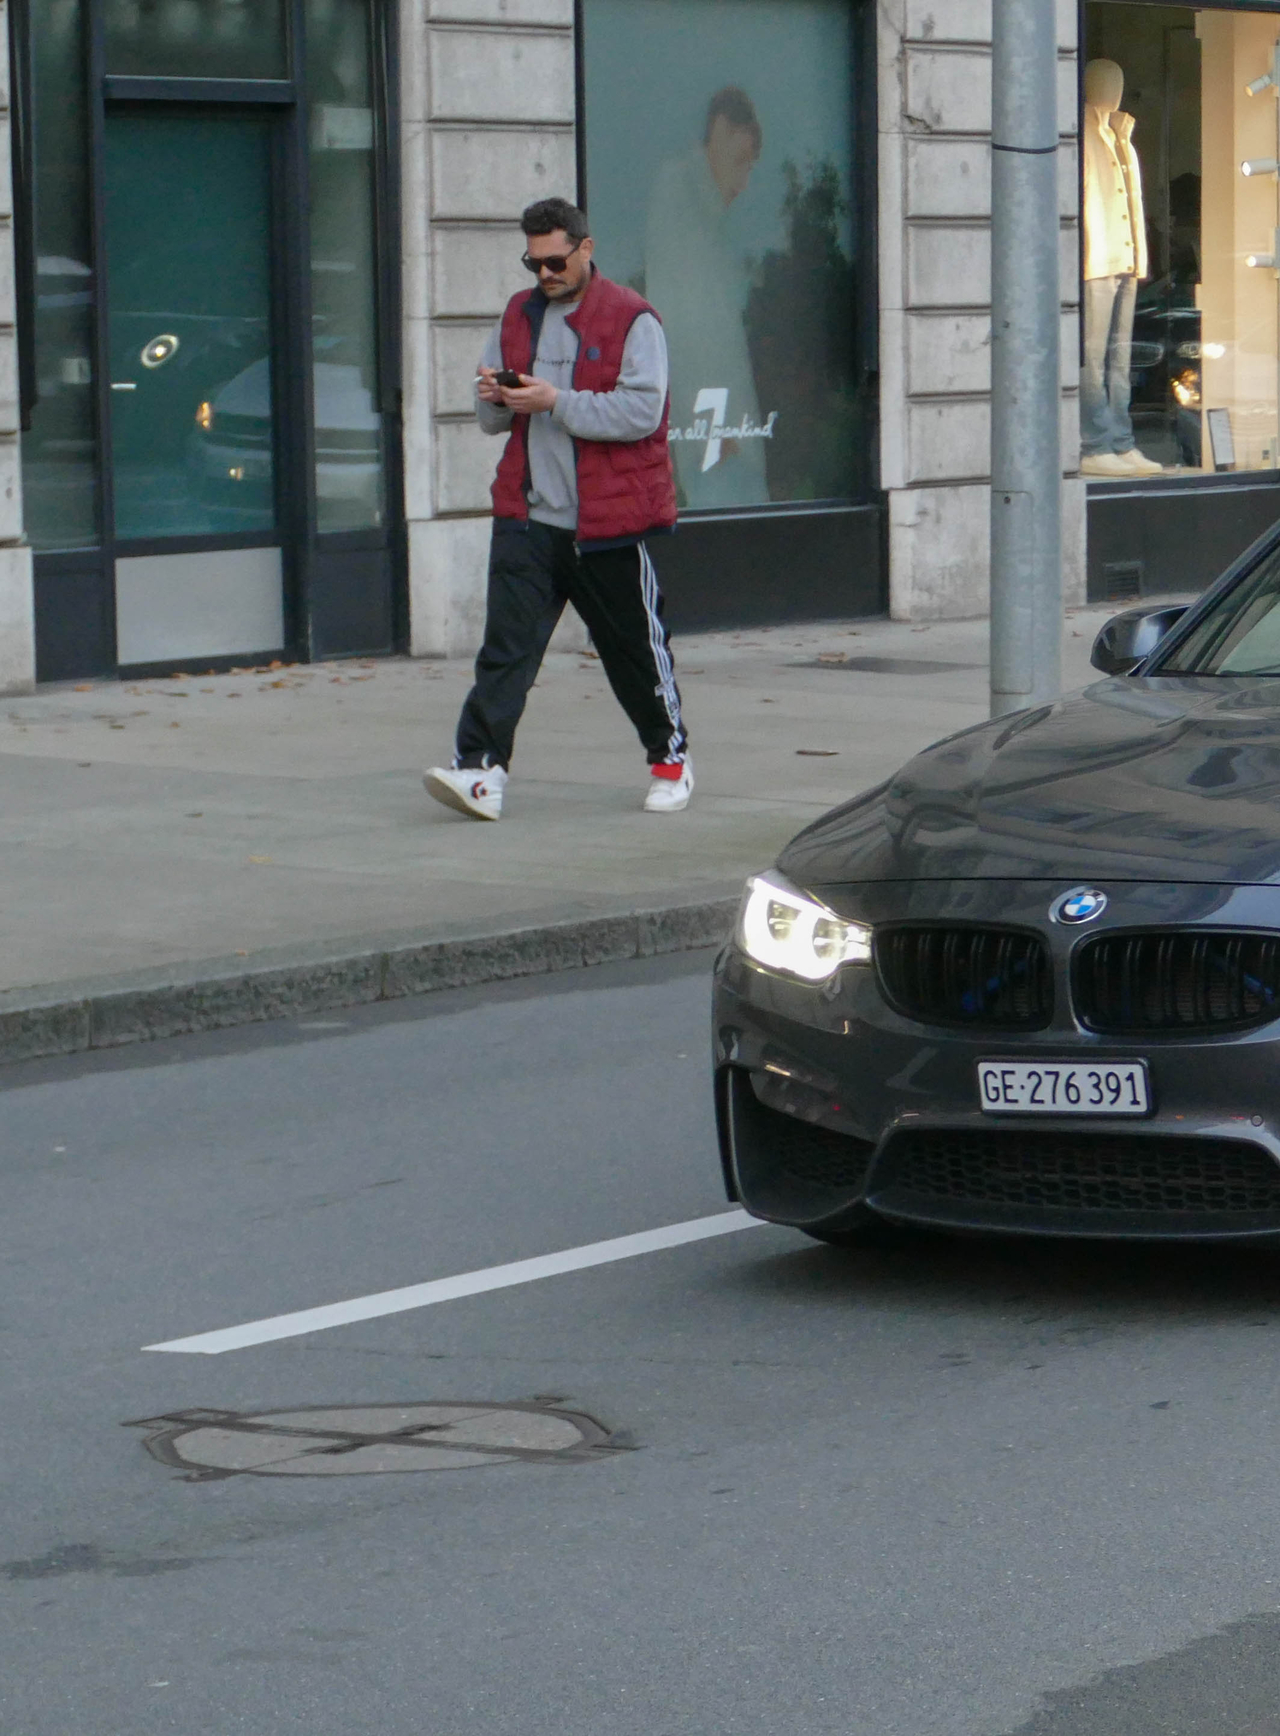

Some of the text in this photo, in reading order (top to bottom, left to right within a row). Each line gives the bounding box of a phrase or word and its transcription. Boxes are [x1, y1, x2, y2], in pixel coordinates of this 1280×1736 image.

[684, 419, 709, 440] all
[711, 411, 778, 439] mankind
[693, 388, 728, 473] 7
